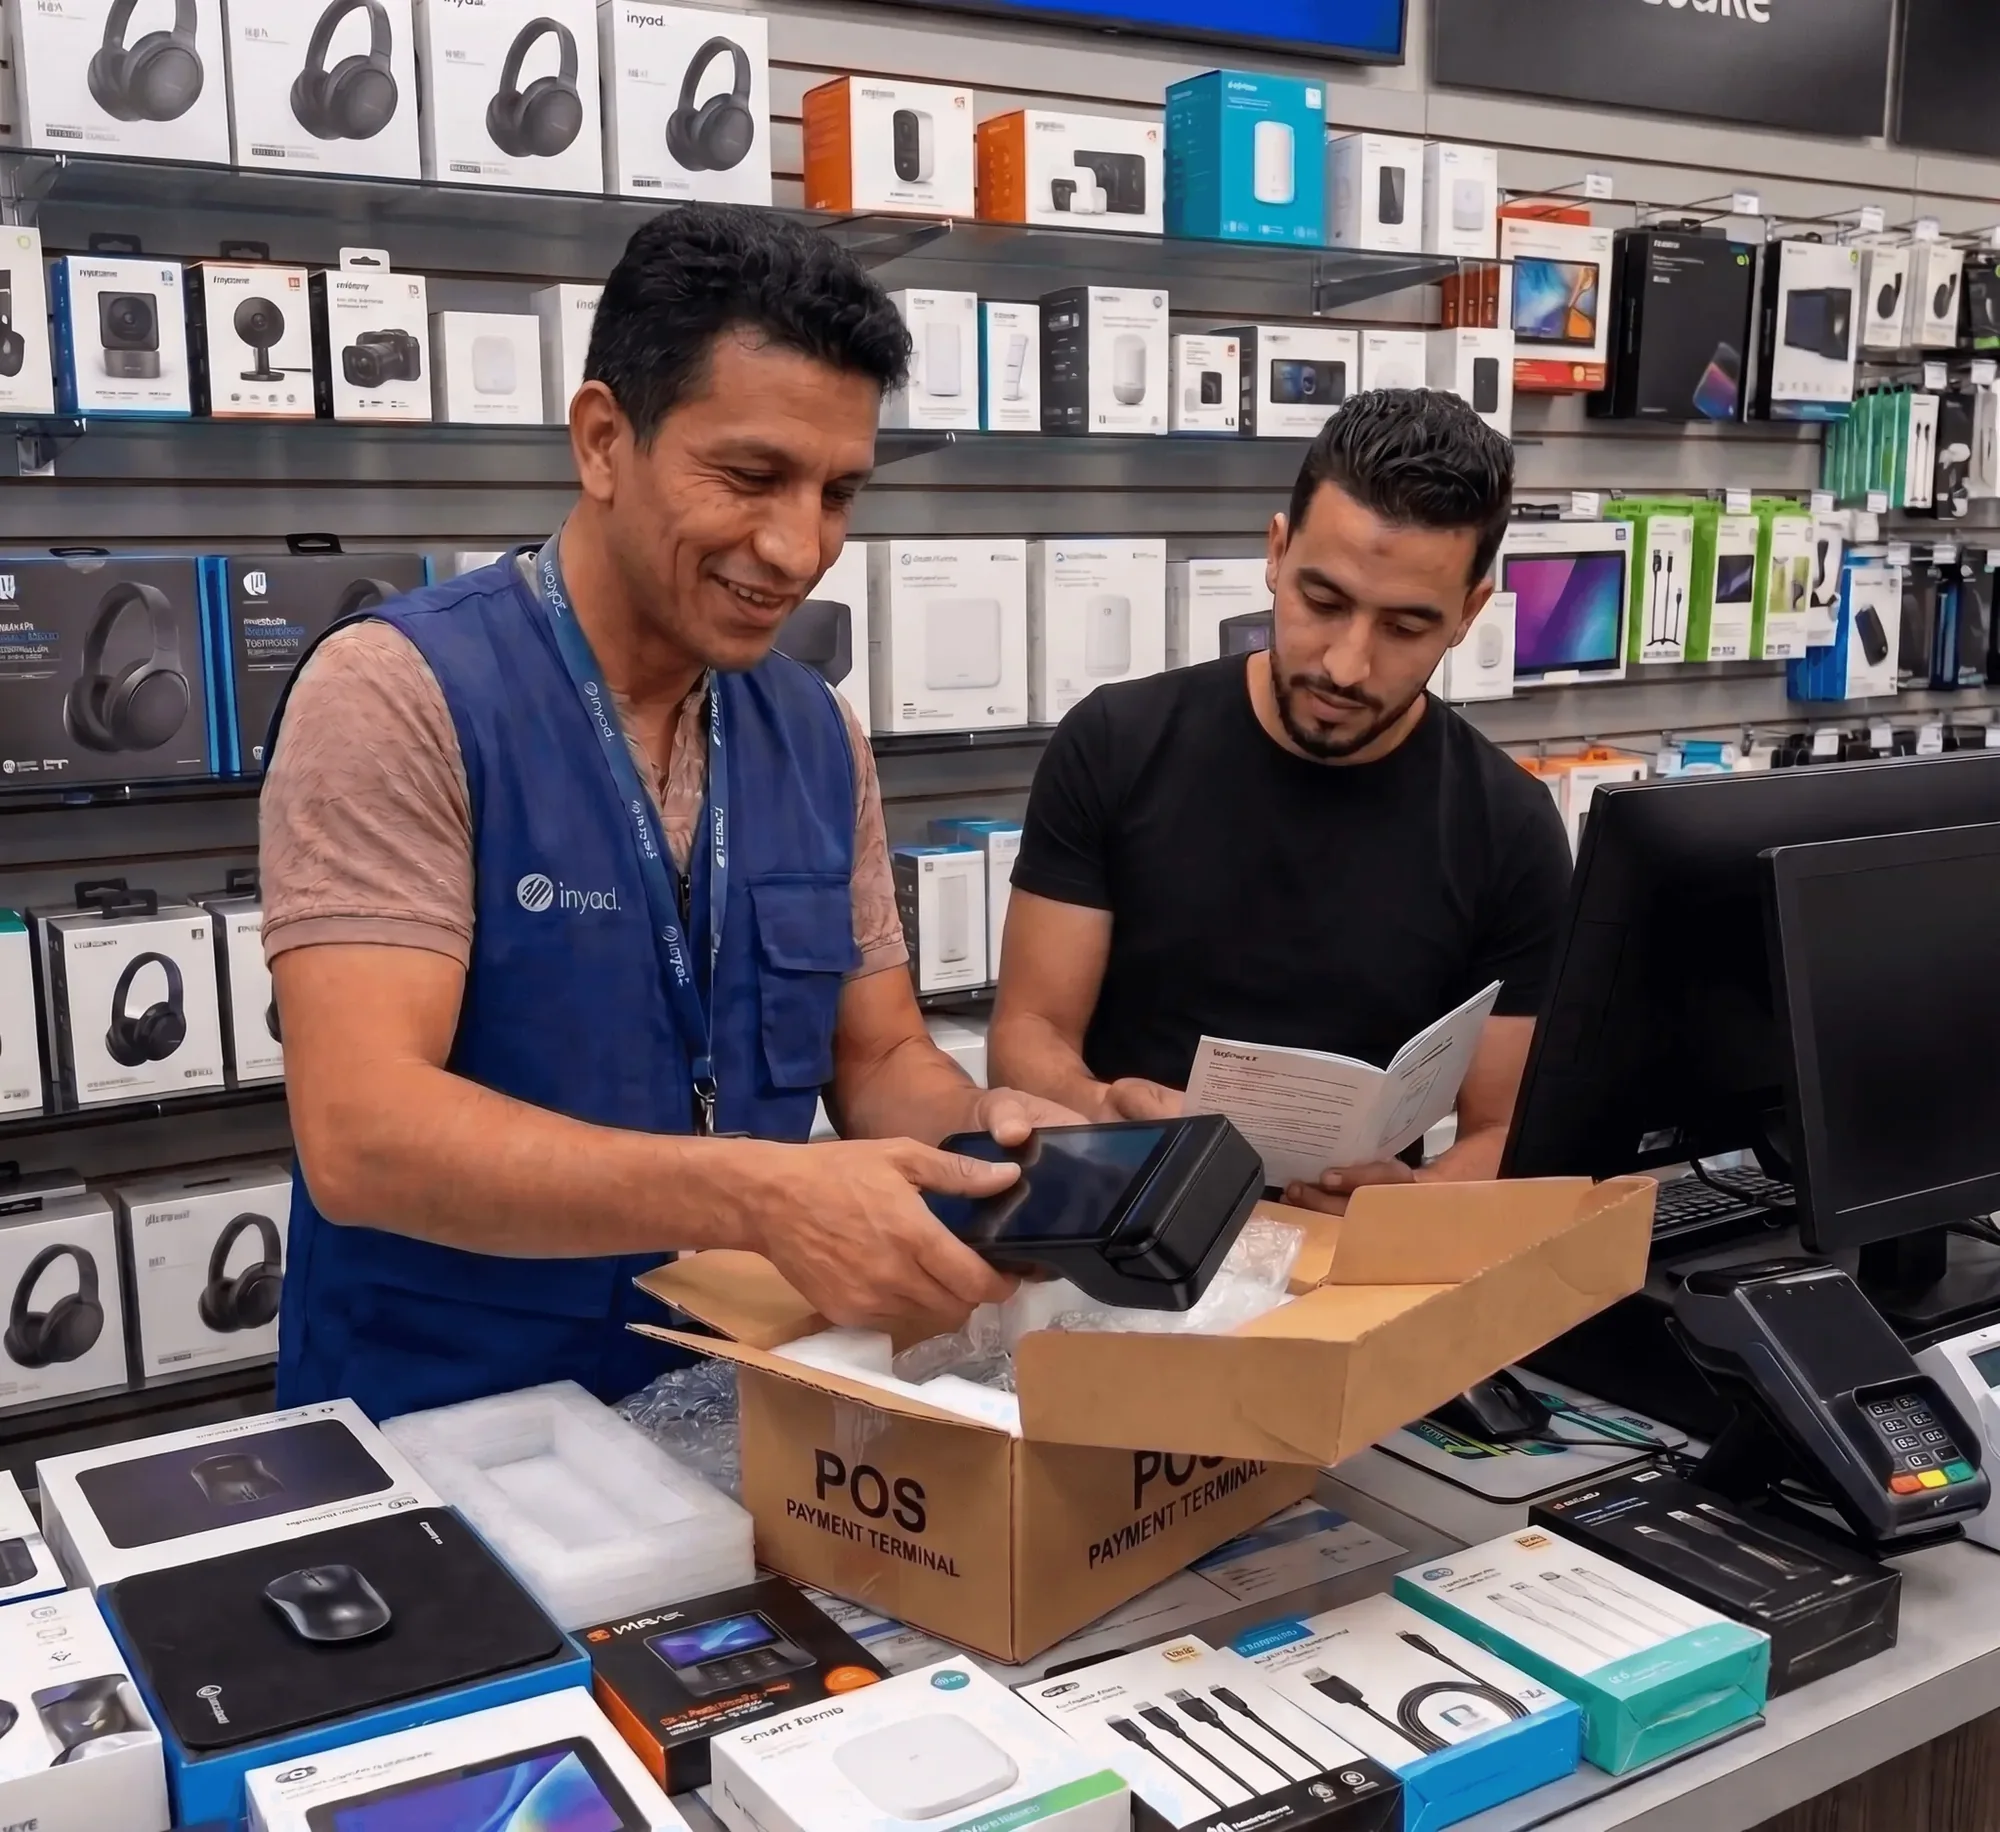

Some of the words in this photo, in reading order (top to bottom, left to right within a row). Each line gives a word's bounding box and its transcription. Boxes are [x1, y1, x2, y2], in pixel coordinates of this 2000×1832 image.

[626, 10, 667, 28] inyad.
[559, 881, 621, 915] inyad.
[814, 1448, 926, 1534] POS
[1088, 1500, 1177, 1570] PAYMENT
[1180, 1459, 1268, 1518] TERMINAL
[1133, 1450, 1225, 1511] PO
[786, 1498, 865, 1543] PAYMENT
[867, 1528, 961, 1578] TERMINAL
